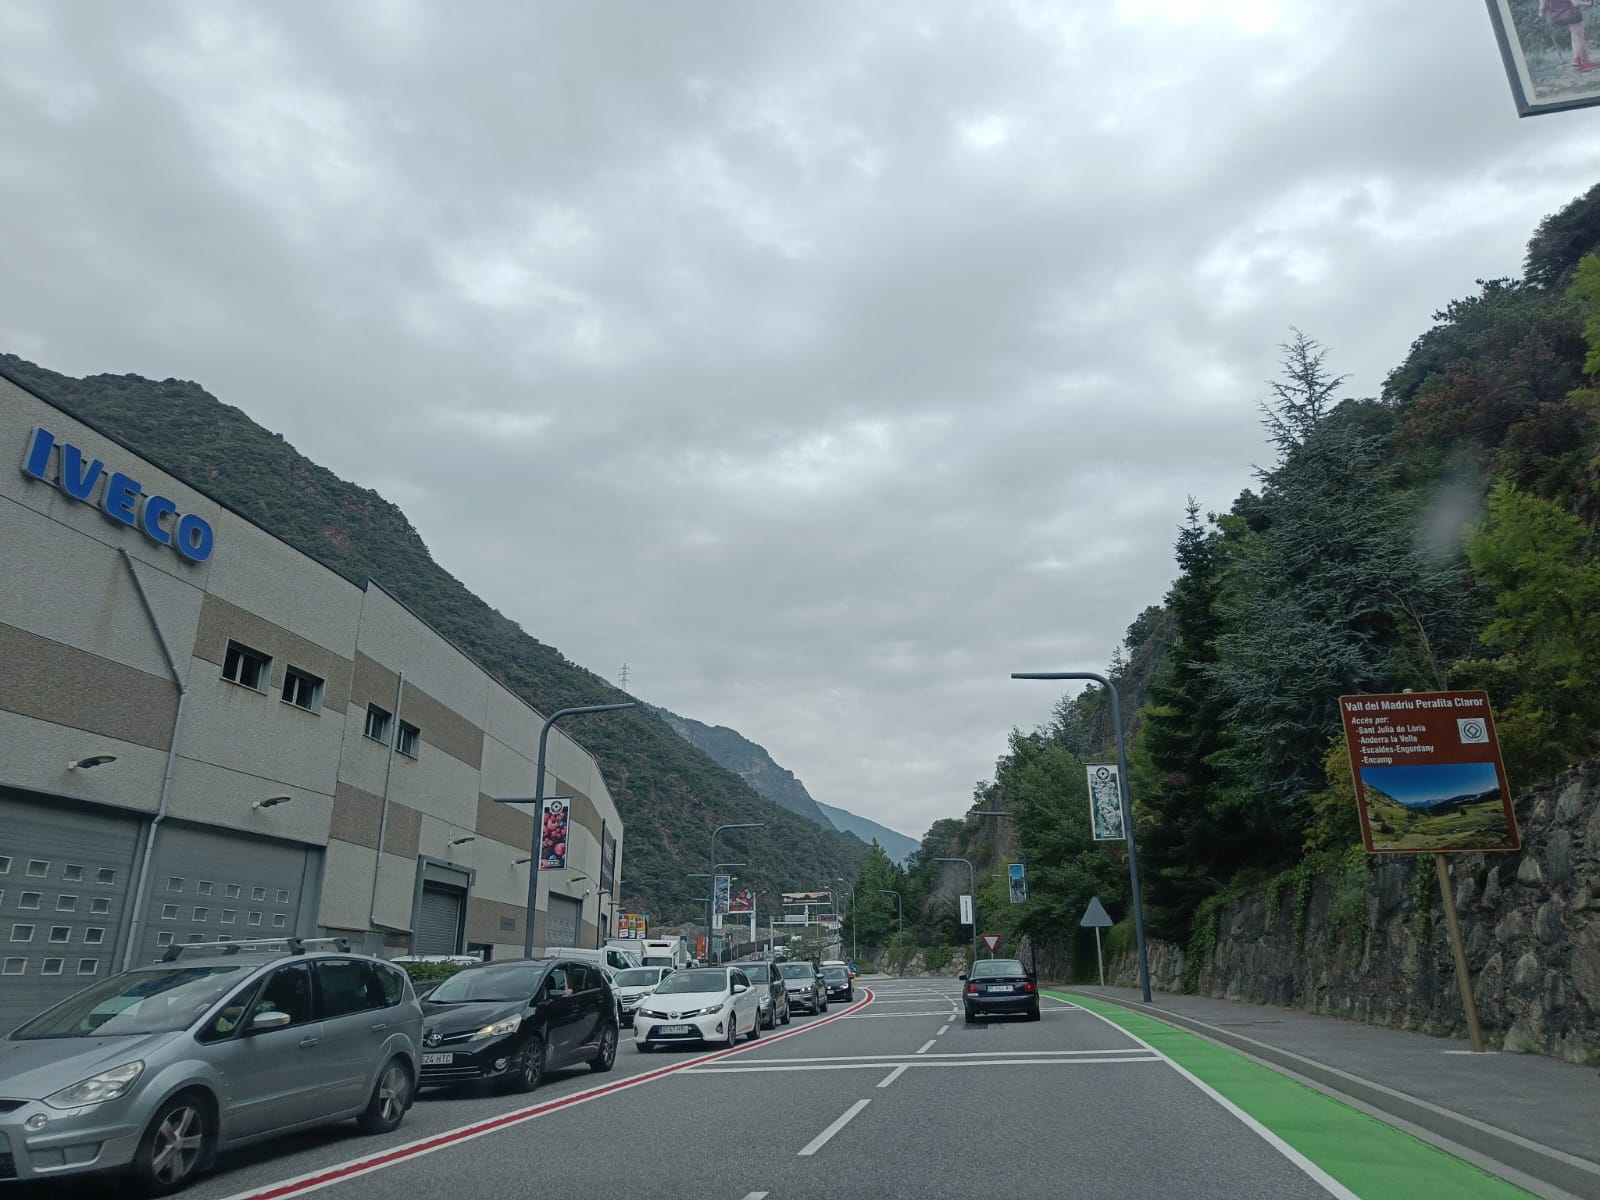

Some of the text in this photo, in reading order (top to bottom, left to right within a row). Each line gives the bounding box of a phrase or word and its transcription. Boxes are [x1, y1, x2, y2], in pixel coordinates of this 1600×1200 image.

[22, 427, 214, 562] IVECO
[1345, 697, 1483, 712] Vall del Madriu Perafita Claror
[1396, 725, 1405, 733] de
[1391, 735, 1398, 743] la
